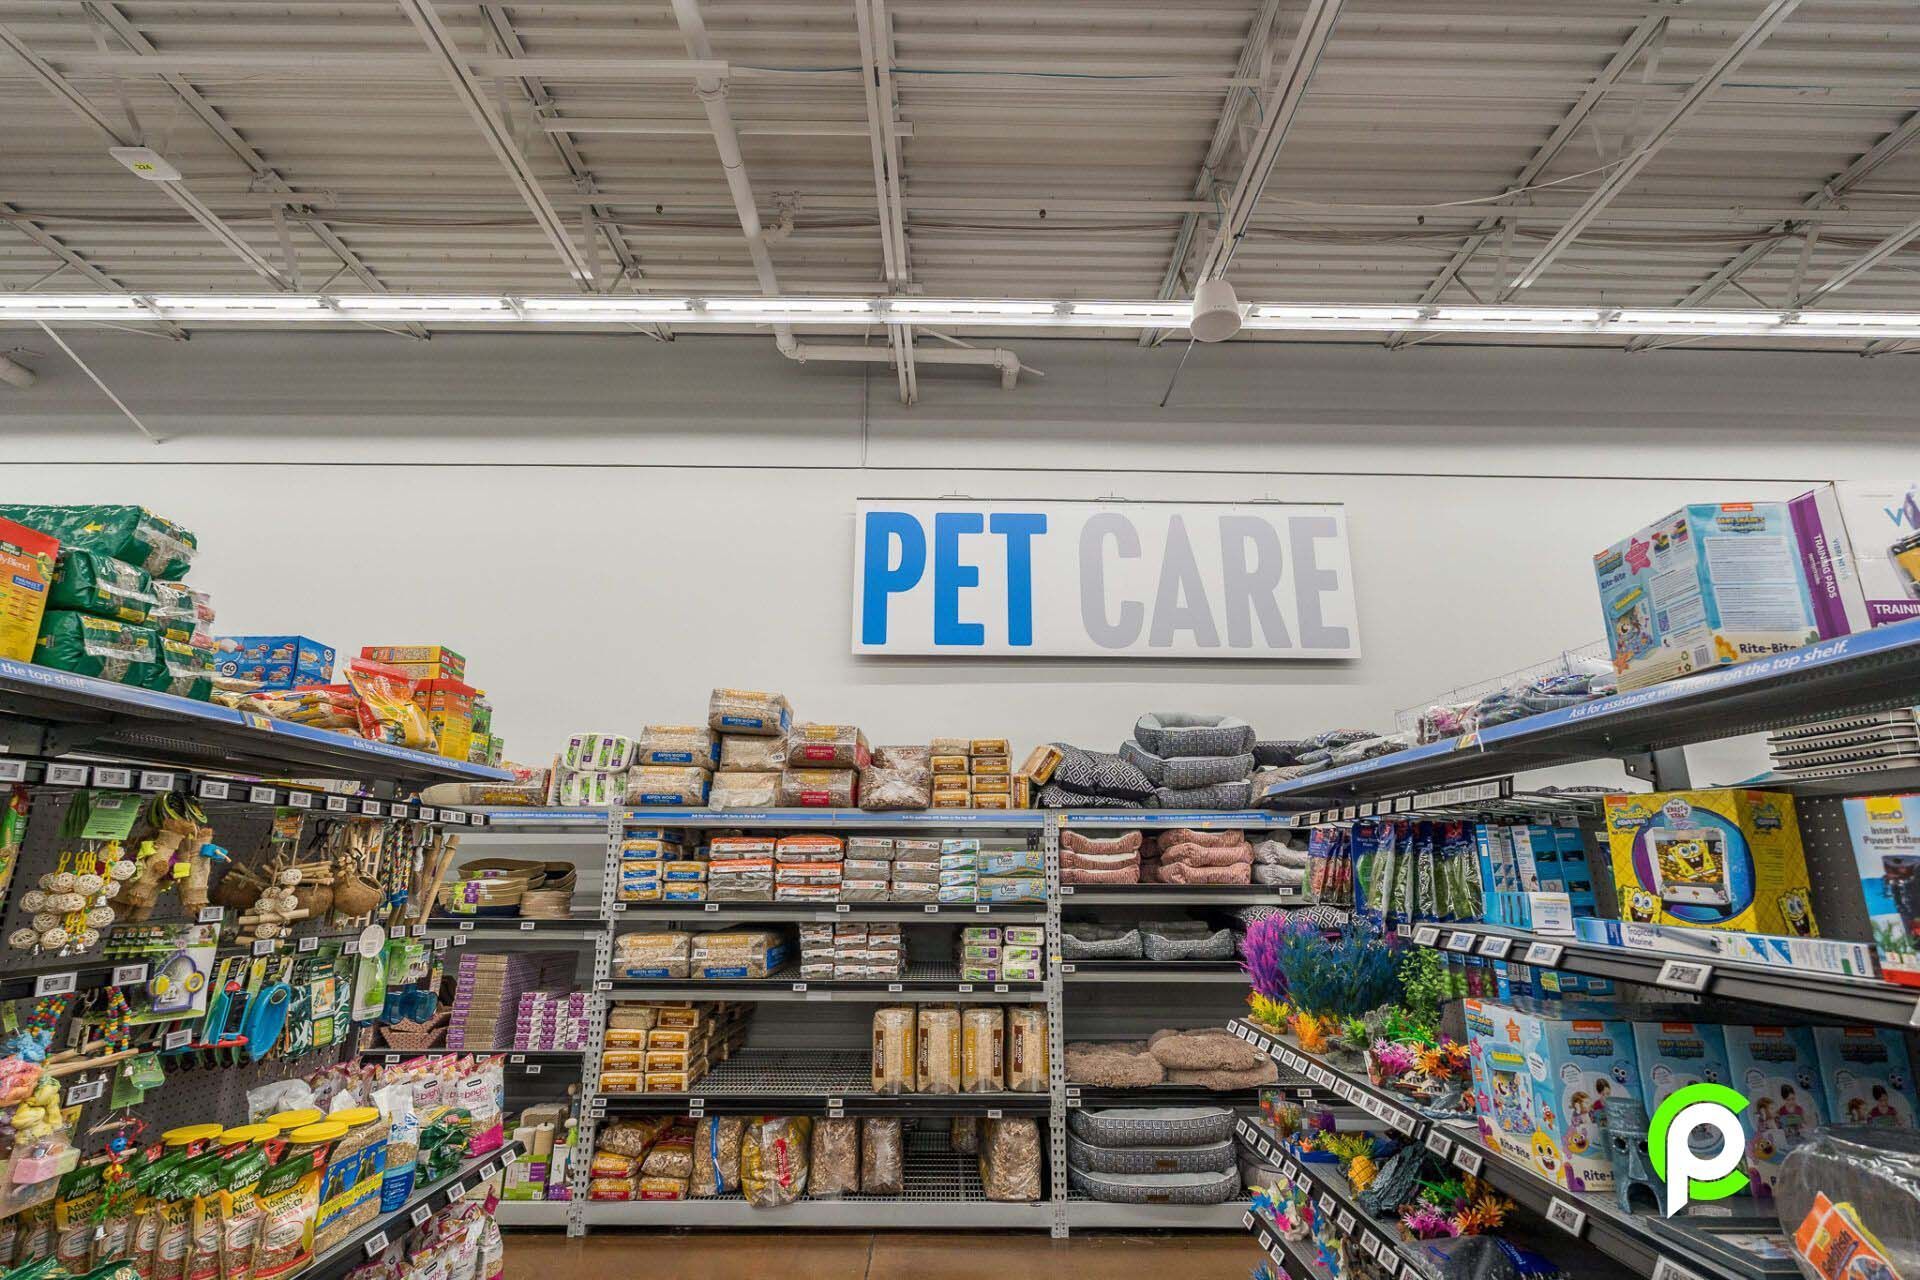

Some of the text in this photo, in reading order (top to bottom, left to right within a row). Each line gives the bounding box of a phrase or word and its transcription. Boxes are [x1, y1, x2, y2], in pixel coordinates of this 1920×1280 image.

[1814, 534, 1833, 575] TRAINING
[1824, 575, 1838, 599] PADS
[862, 511, 1351, 649] PET CARE
[2, 662, 88, 690] the top shelf.
[224, 664, 235, 672] 40
[1568, 640, 1849, 720] Ask for assistance with items on the top shelf.
[1863, 836, 1894, 844] Power
[1870, 826, 1909, 834] Internal
[229, 1168, 262, 1192] Harvest
